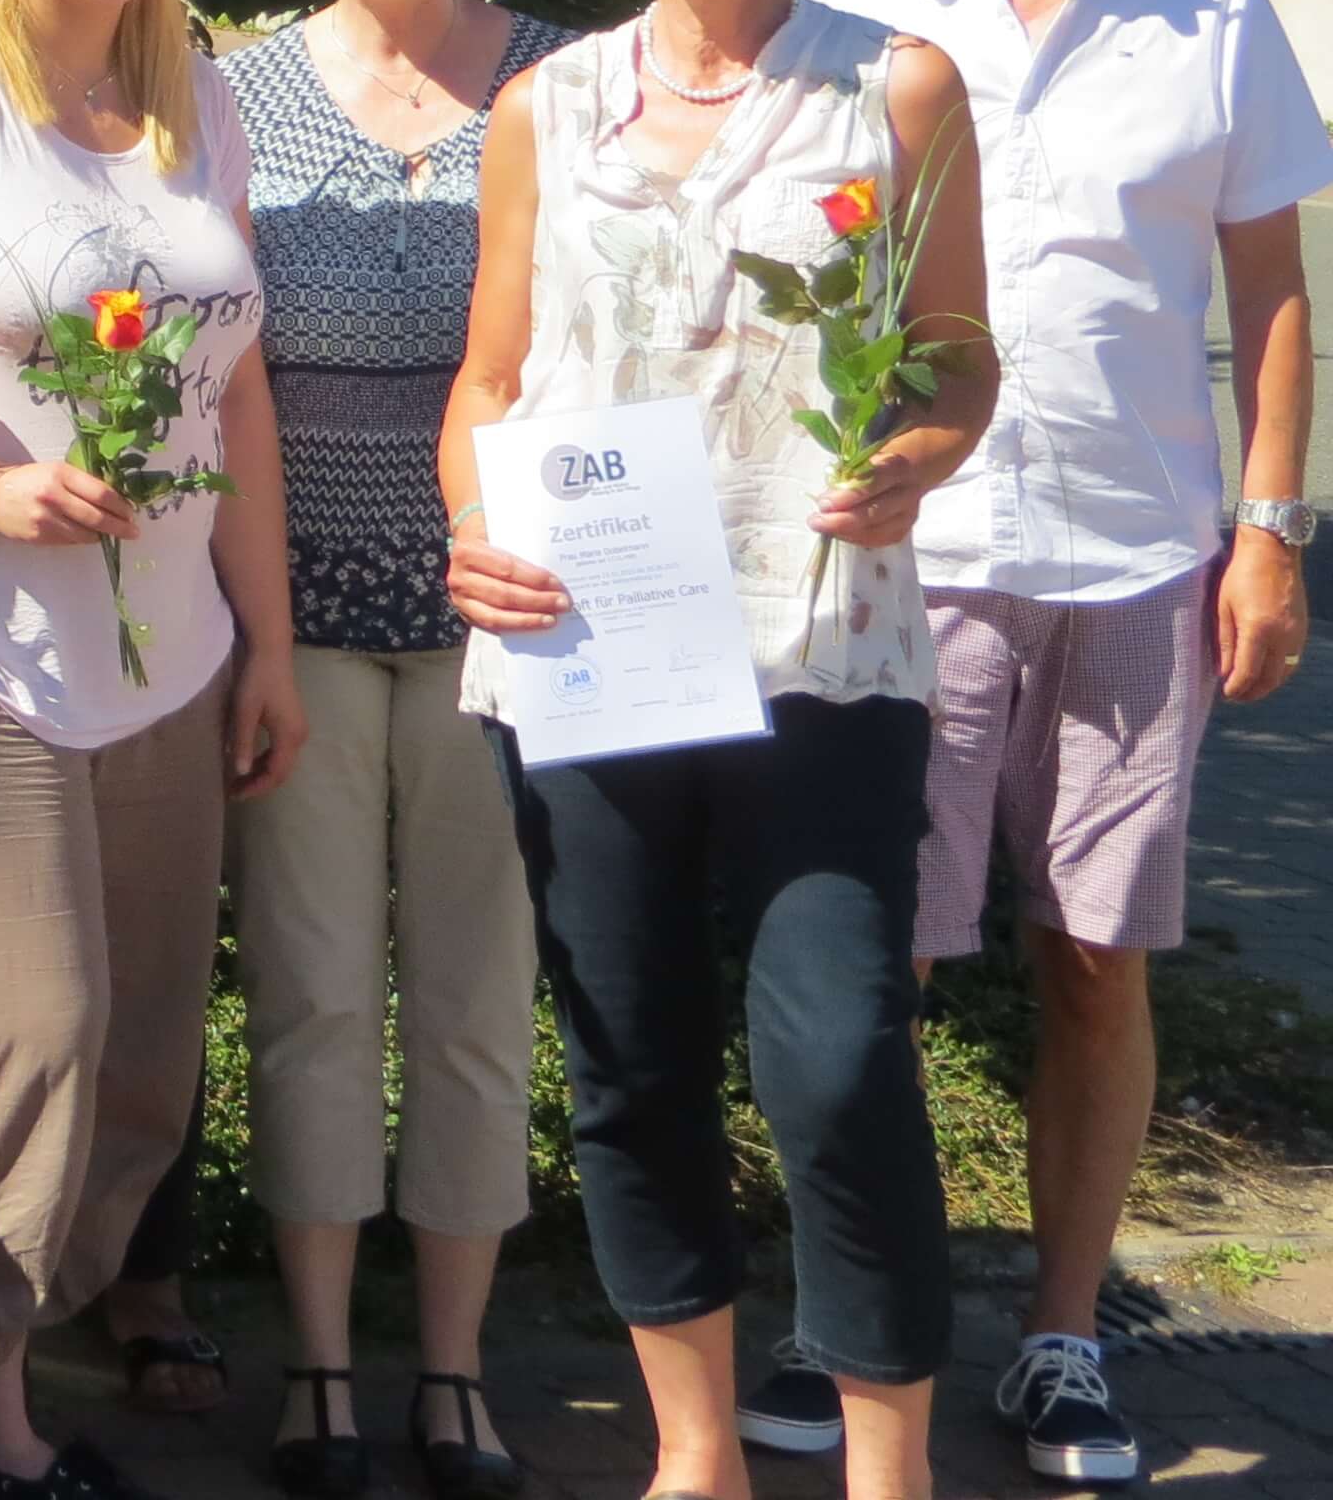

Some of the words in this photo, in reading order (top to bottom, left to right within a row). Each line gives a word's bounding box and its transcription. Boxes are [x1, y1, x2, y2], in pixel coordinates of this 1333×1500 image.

[559, 449, 626, 487] ZAB
[549, 513, 653, 543] Zertifikat
[595, 595, 613, 609] für
[618, 587, 675, 605] Palliative
[678, 582, 709, 596] Care
[563, 669, 590, 687] ZAB
